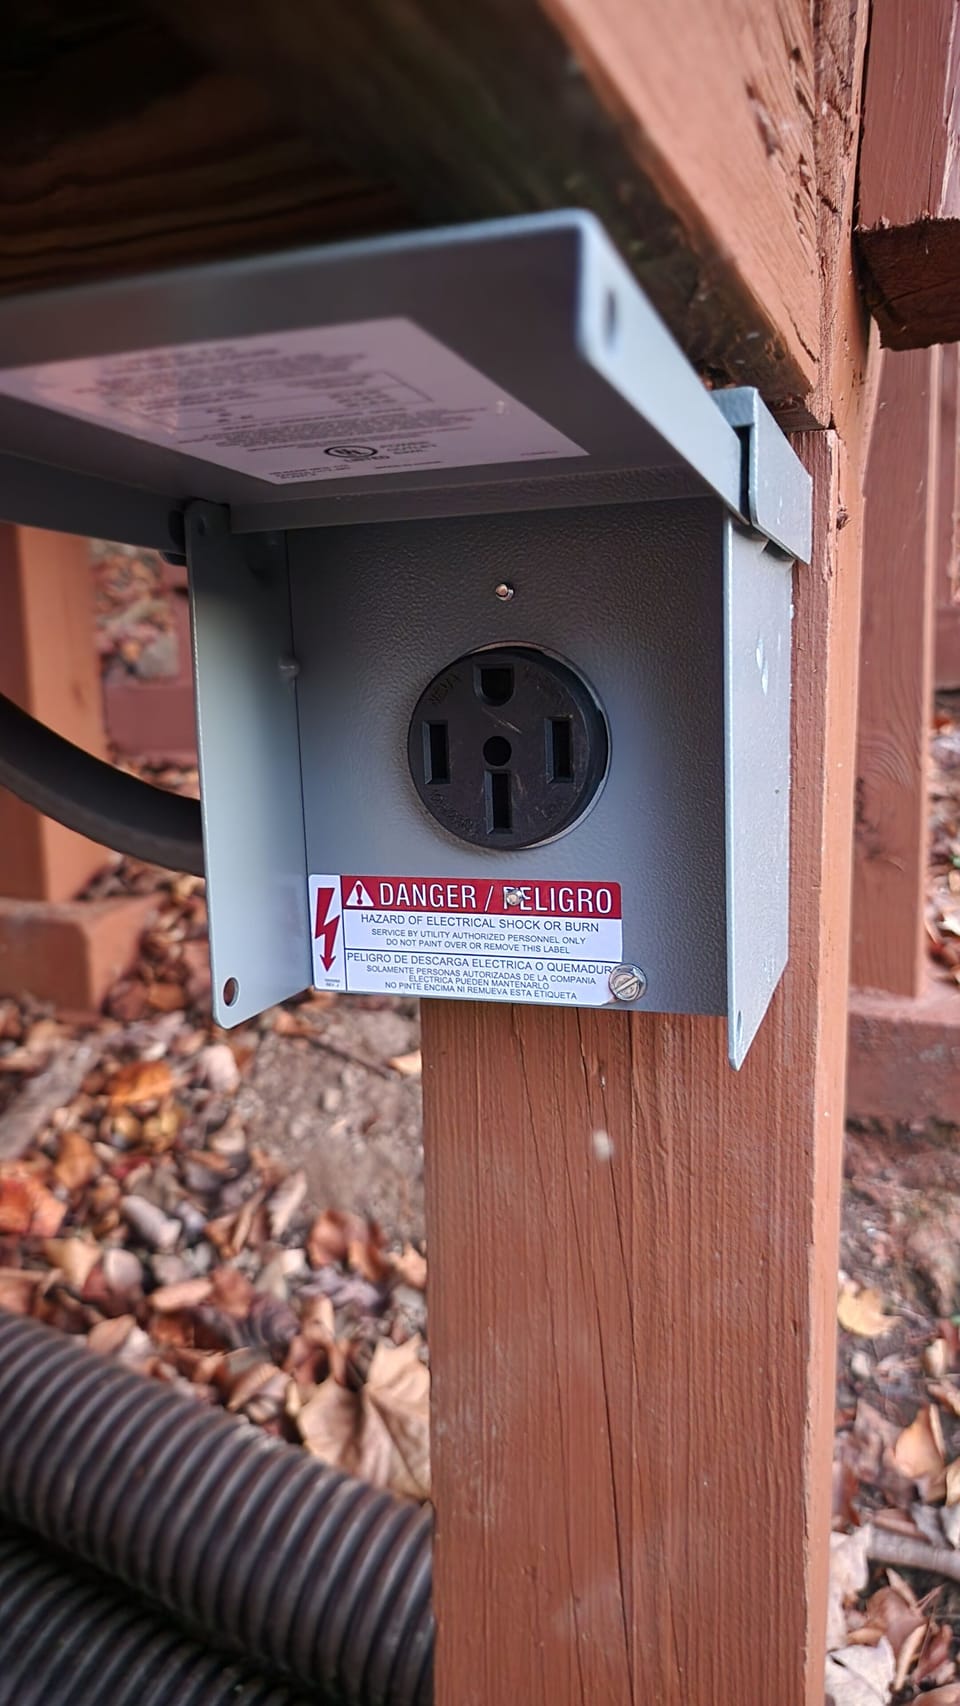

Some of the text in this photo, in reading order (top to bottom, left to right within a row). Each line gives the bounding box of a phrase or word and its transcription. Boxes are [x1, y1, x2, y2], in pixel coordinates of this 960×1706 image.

[379, 882, 612, 914] DANGER / PELIGRO
[361, 914, 599, 932] HAZARD OF ELECTRICAL SHOCK OR BURN
[371, 928, 586, 945] SERVICE BY UTILITY AUTHORIZED PERSONNEL ONLY
[386, 938, 570, 954] DO NOT PAINT OVER OR REMOVE THIS LABEL
[347, 952, 612, 975] PELIGRO DE DESCARGA ELECTRICA O QUEMADUR
[366, 965, 596, 985] SOLAMENTE PERSONAS AUTORIZADAS DE LA COMPANIA
[409, 975, 550, 990] ELECTRICA PUEDEN MANTENARLO
[385, 981, 577, 1000] NO PINTE ENCIMA NI REMUEVA ESTA ETIQUETA
